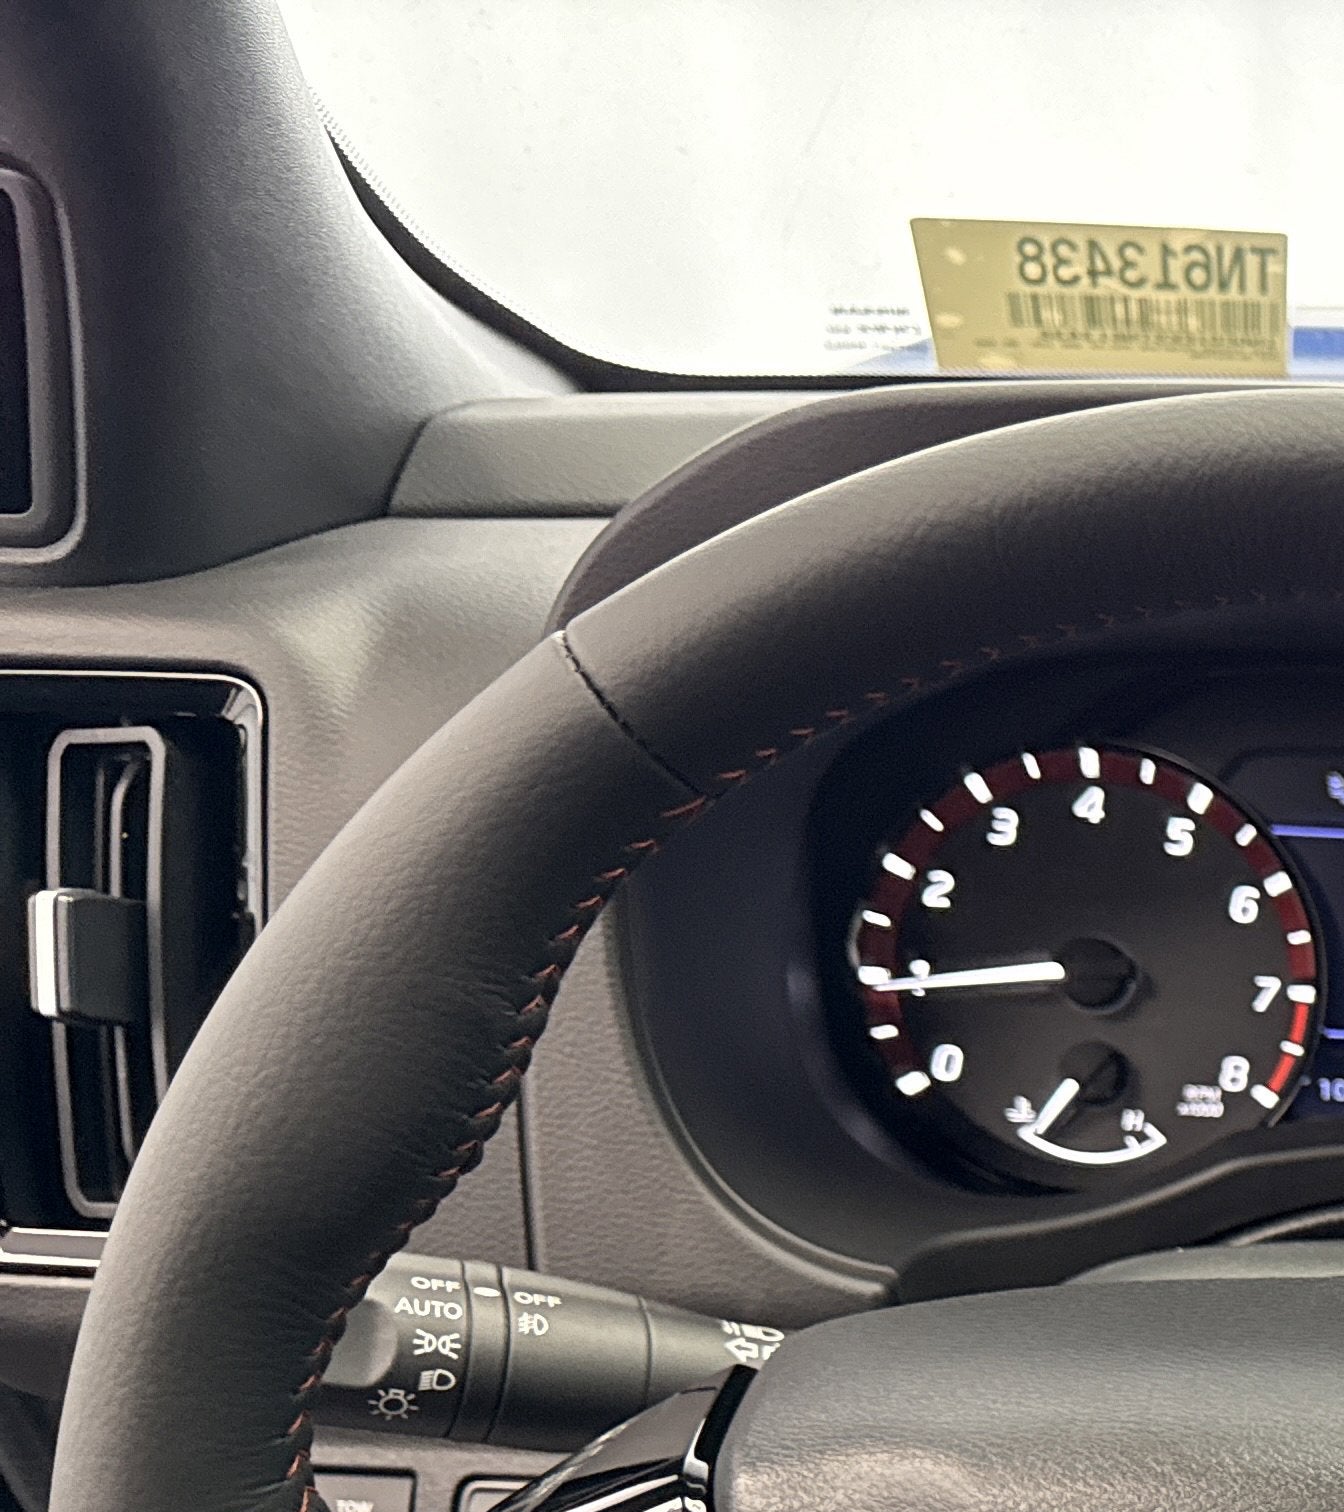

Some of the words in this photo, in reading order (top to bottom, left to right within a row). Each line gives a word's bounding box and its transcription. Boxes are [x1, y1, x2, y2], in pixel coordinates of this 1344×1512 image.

[1072, 786, 1105, 824] 4
[986, 807, 1019, 846] 3
[1163, 817, 1195, 856] 5
[922, 870, 955, 908] 2
[1228, 886, 1260, 924] 6
[1253, 975, 1283, 1013] 7
[931, 1044, 964, 1082] 0
[1218, 1056, 1250, 1092] 8
[411, 1275, 461, 1294] OFF
[513, 1290, 562, 1308] OFF
[394, 1295, 464, 1321] AUTO
